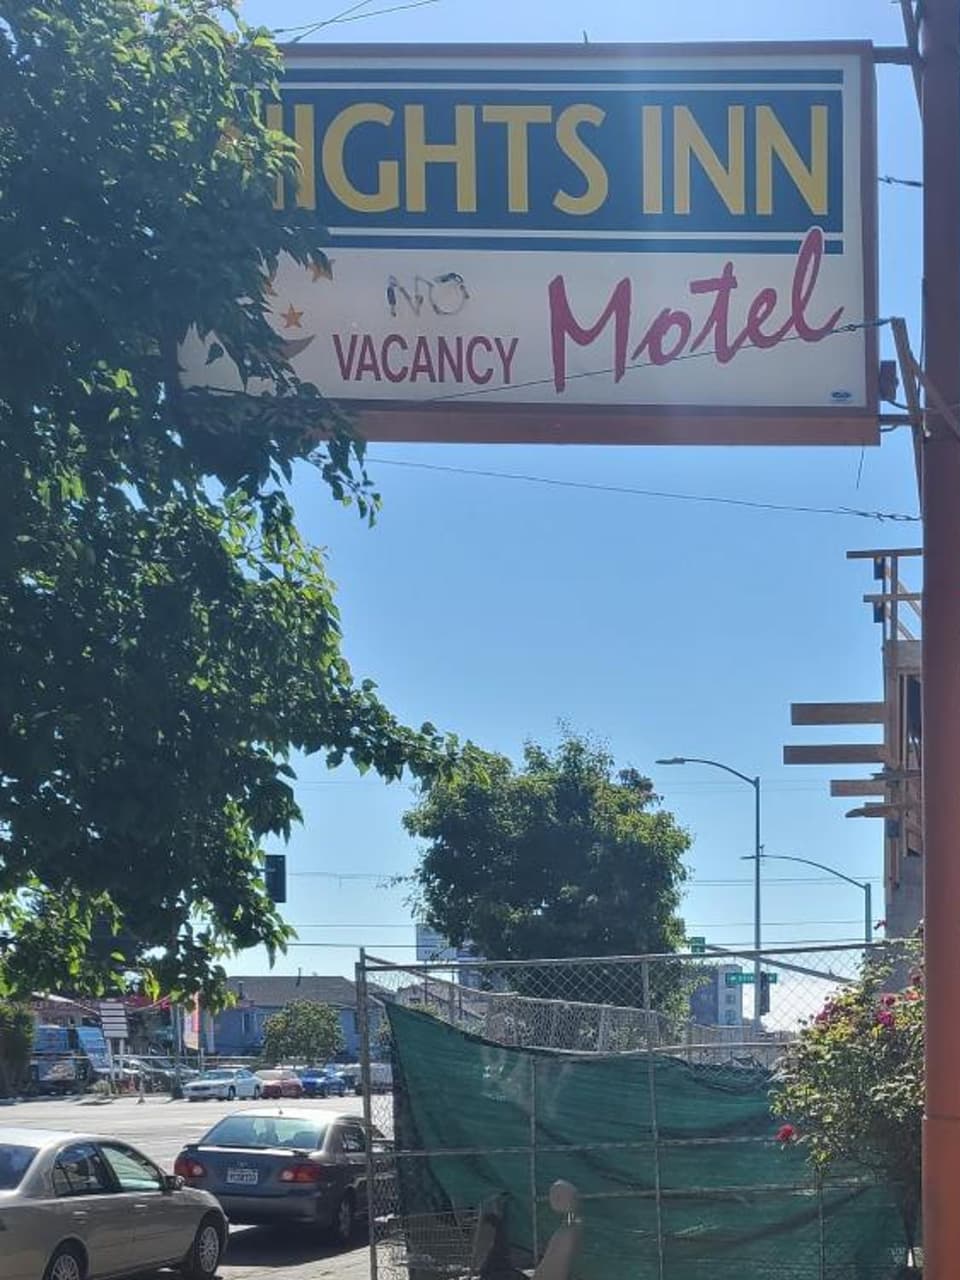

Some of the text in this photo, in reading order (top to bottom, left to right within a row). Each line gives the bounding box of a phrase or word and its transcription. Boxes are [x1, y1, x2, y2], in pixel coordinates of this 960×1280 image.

[264, 102, 829, 217] IGHTS INN
[386, 271, 471, 318] NO
[547, 227, 844, 394] Motel
[331, 333, 520, 385] VACANCY
